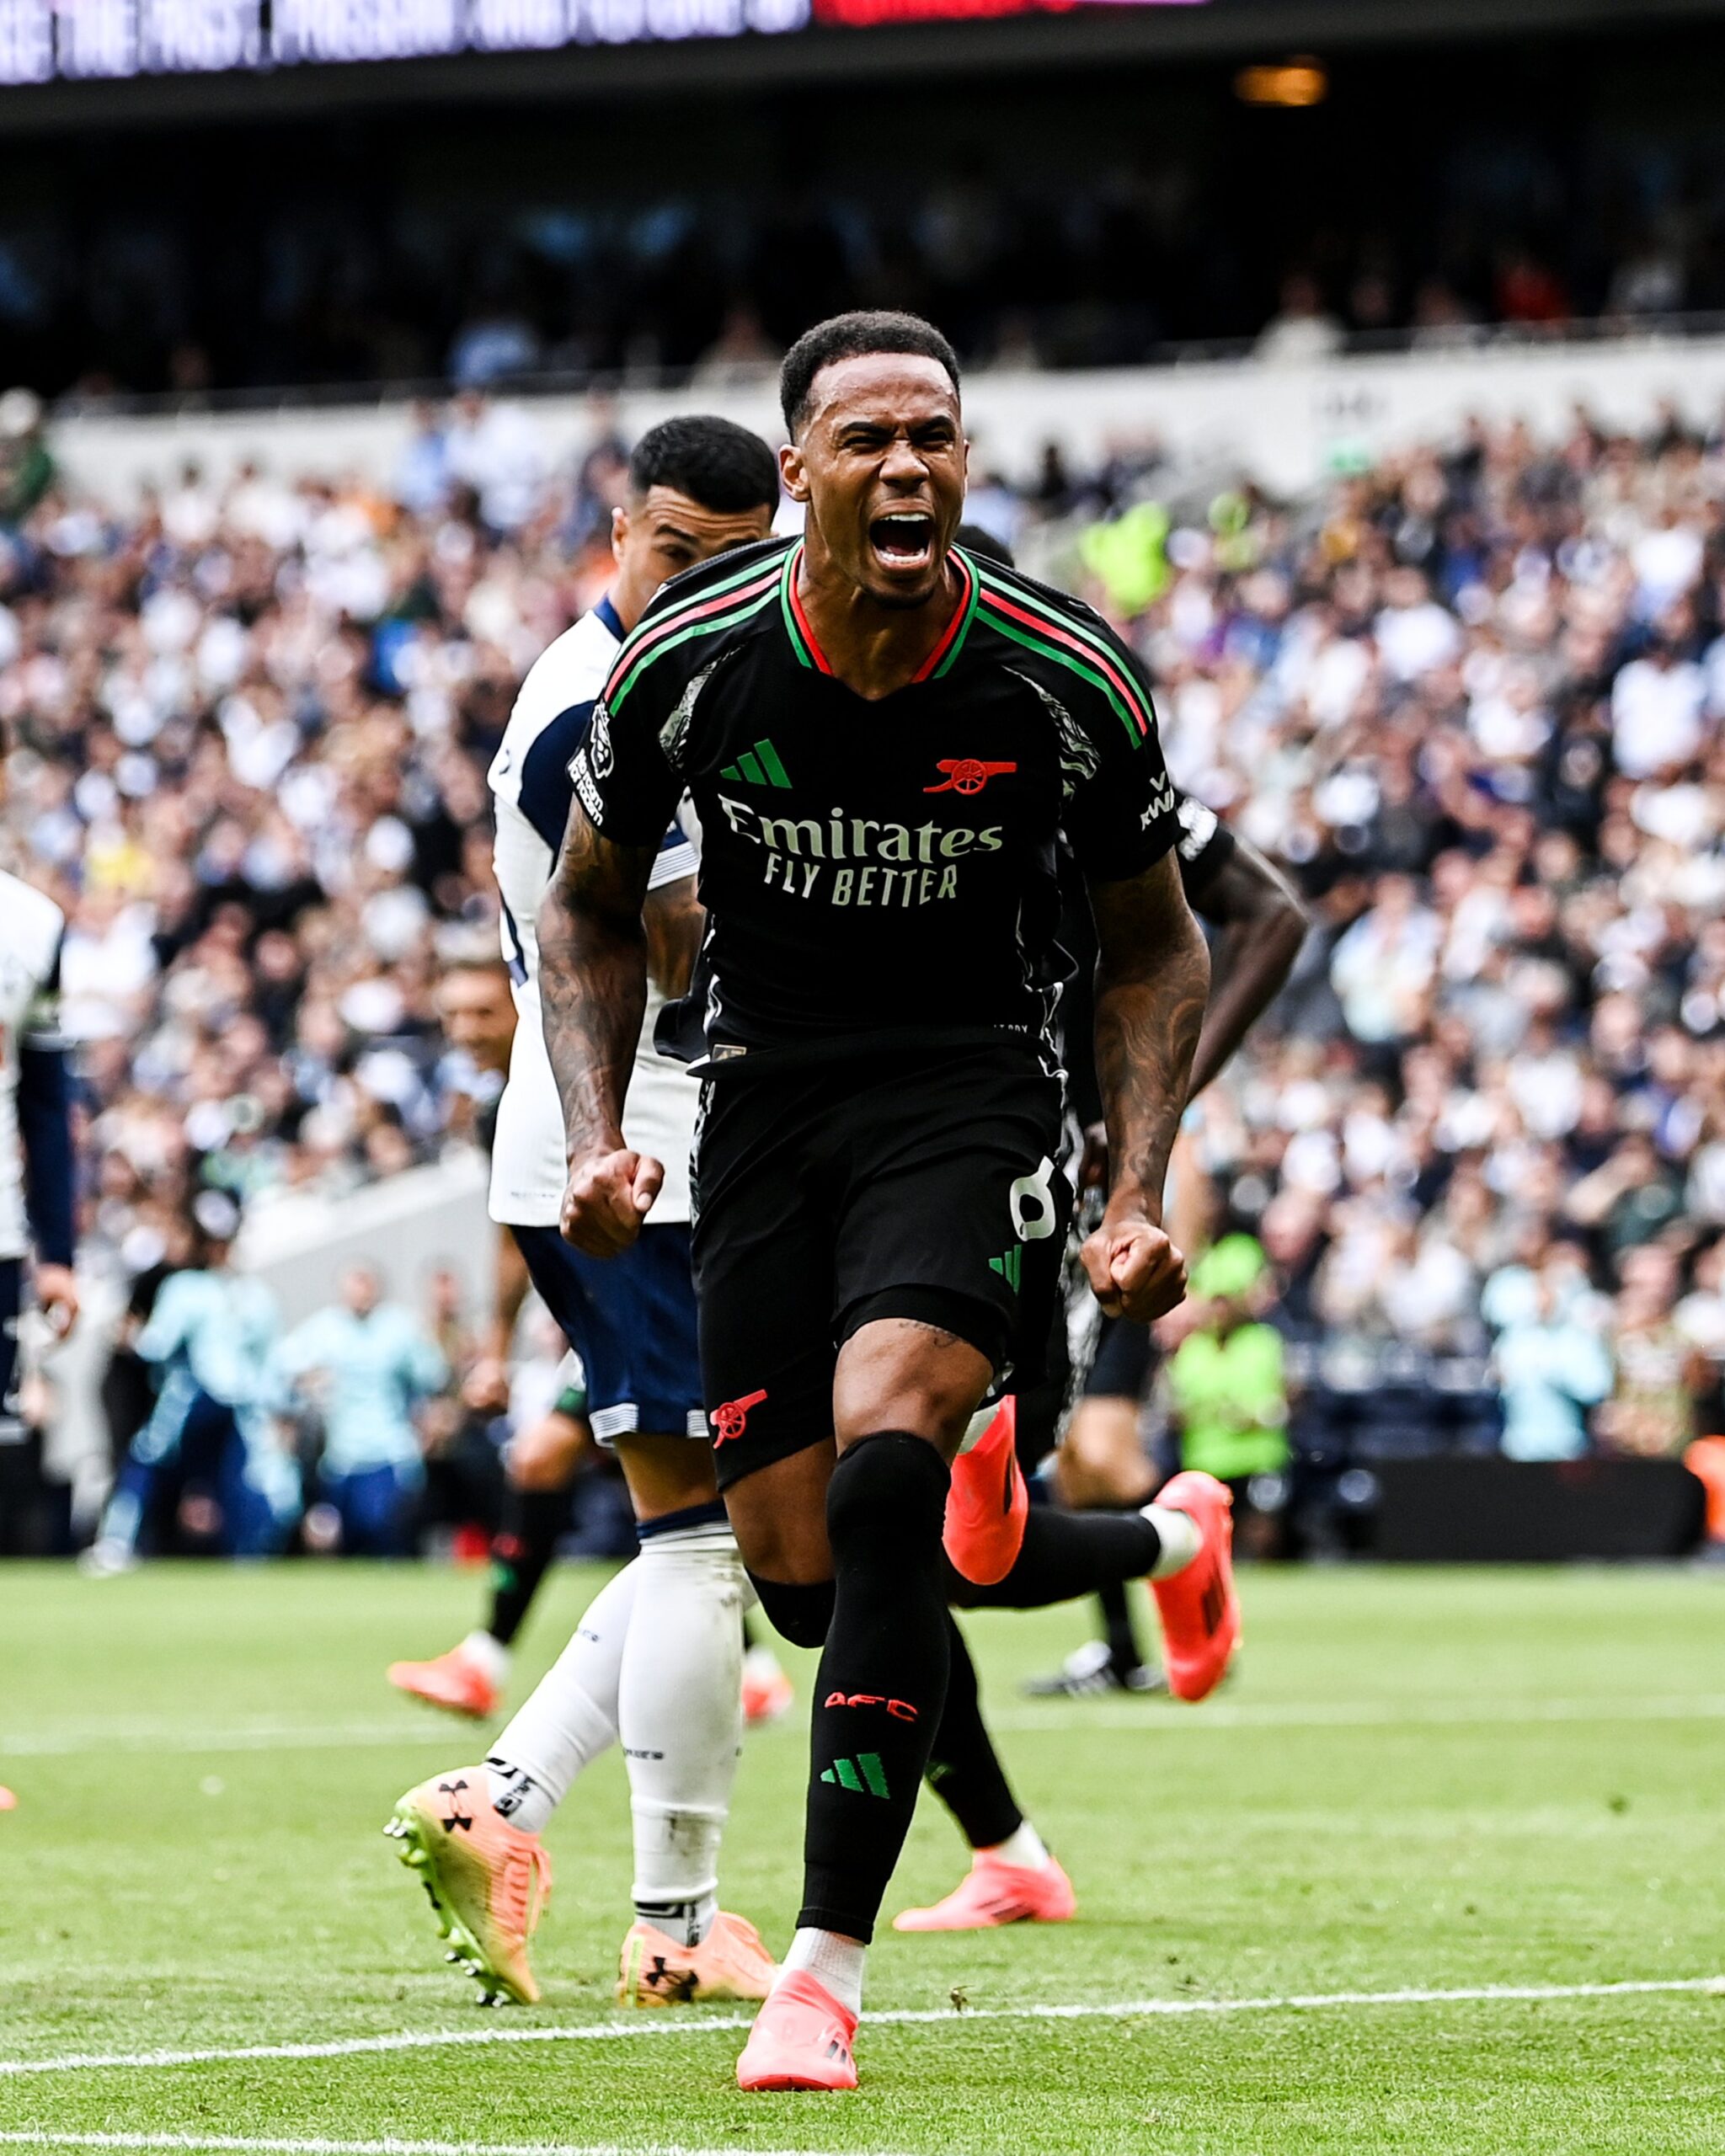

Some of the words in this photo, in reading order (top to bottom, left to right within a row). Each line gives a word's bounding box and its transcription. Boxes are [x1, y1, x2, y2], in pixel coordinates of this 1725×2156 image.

[718, 793, 1002, 864] Emirates
[764, 853, 821, 899] FLY
[831, 864, 958, 908] BETTER
[825, 1691, 918, 1722] AFC
